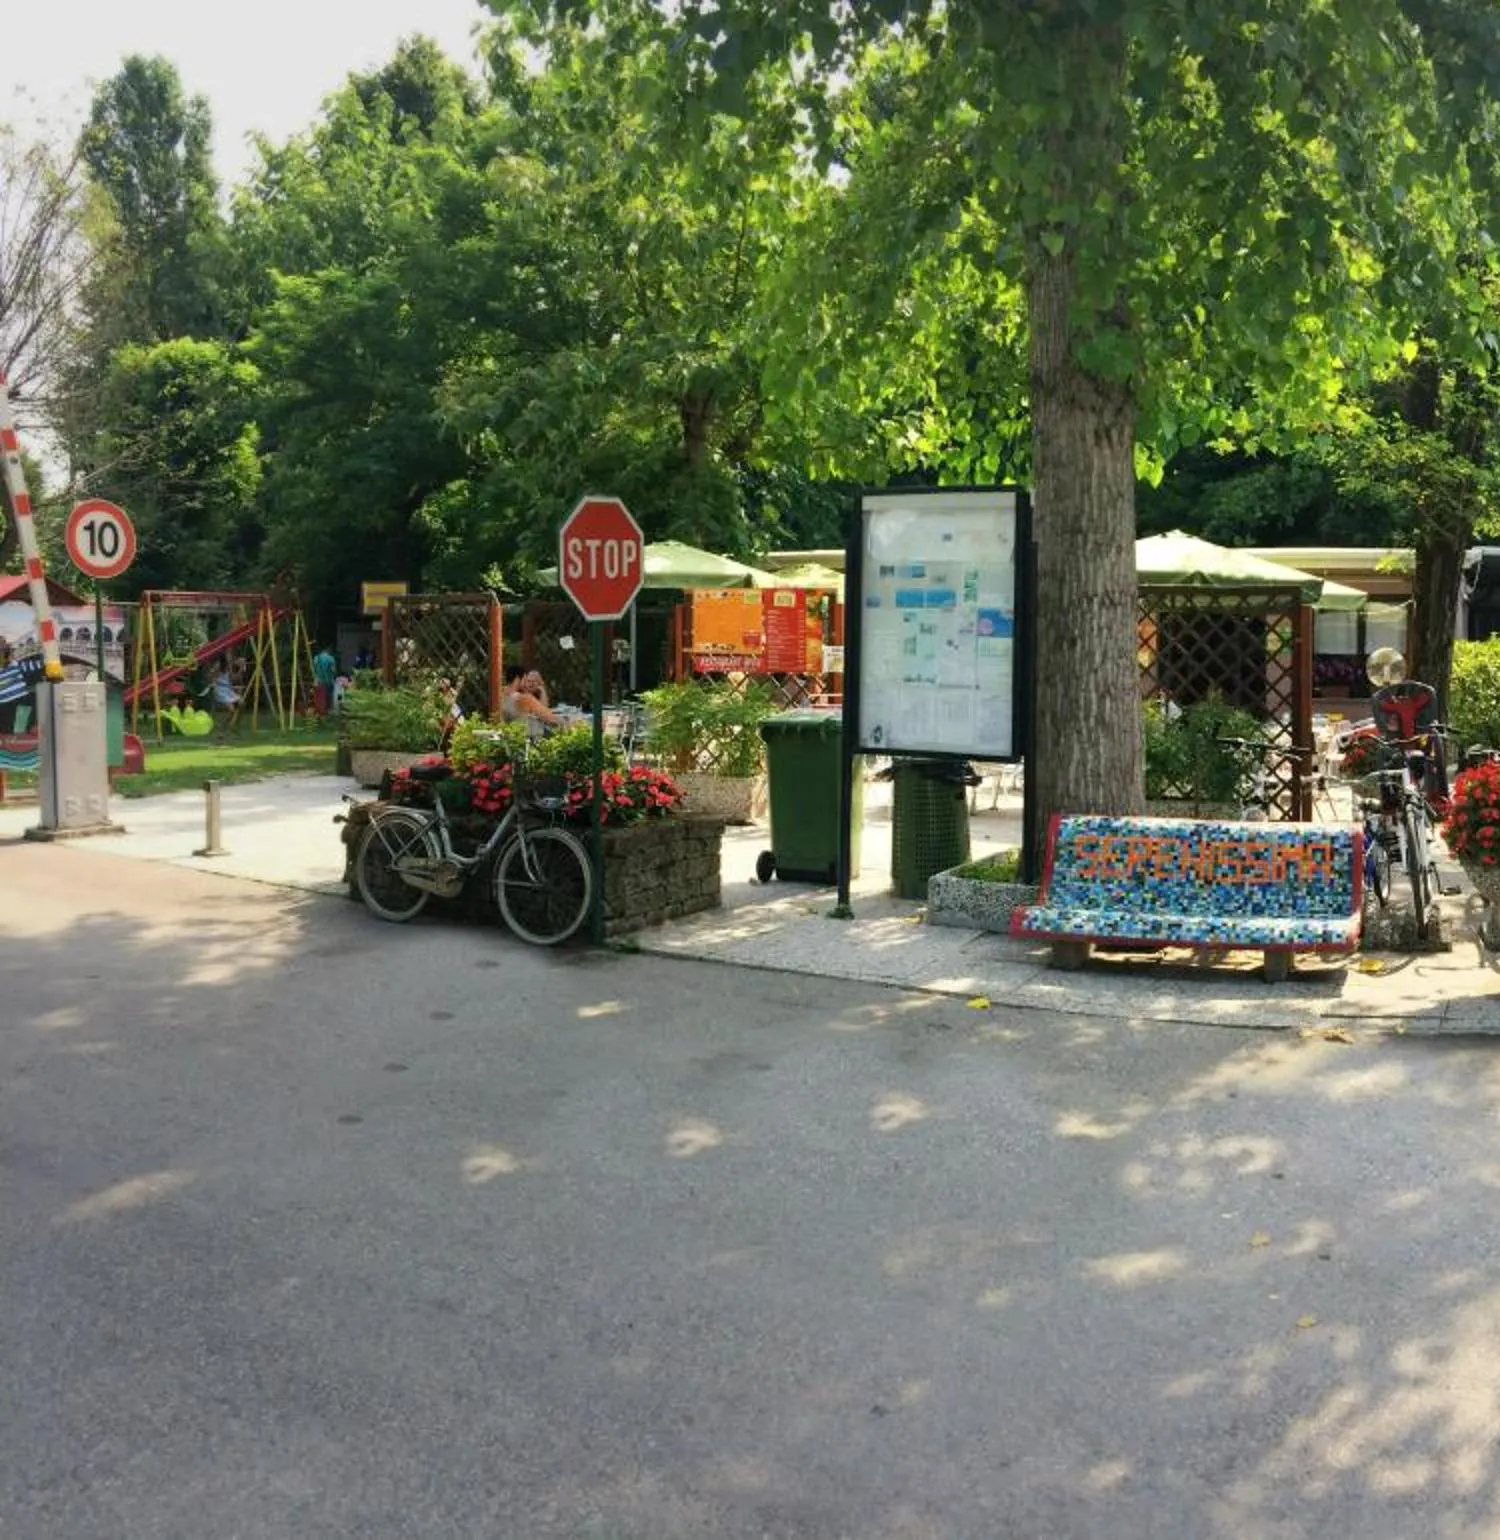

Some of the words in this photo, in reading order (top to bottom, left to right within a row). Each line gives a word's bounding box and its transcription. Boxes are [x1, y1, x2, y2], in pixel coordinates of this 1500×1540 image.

[83, 520, 119, 558] 10
[568, 537, 637, 579] STOP
[1075, 834, 1332, 885] SERENISSIMA
